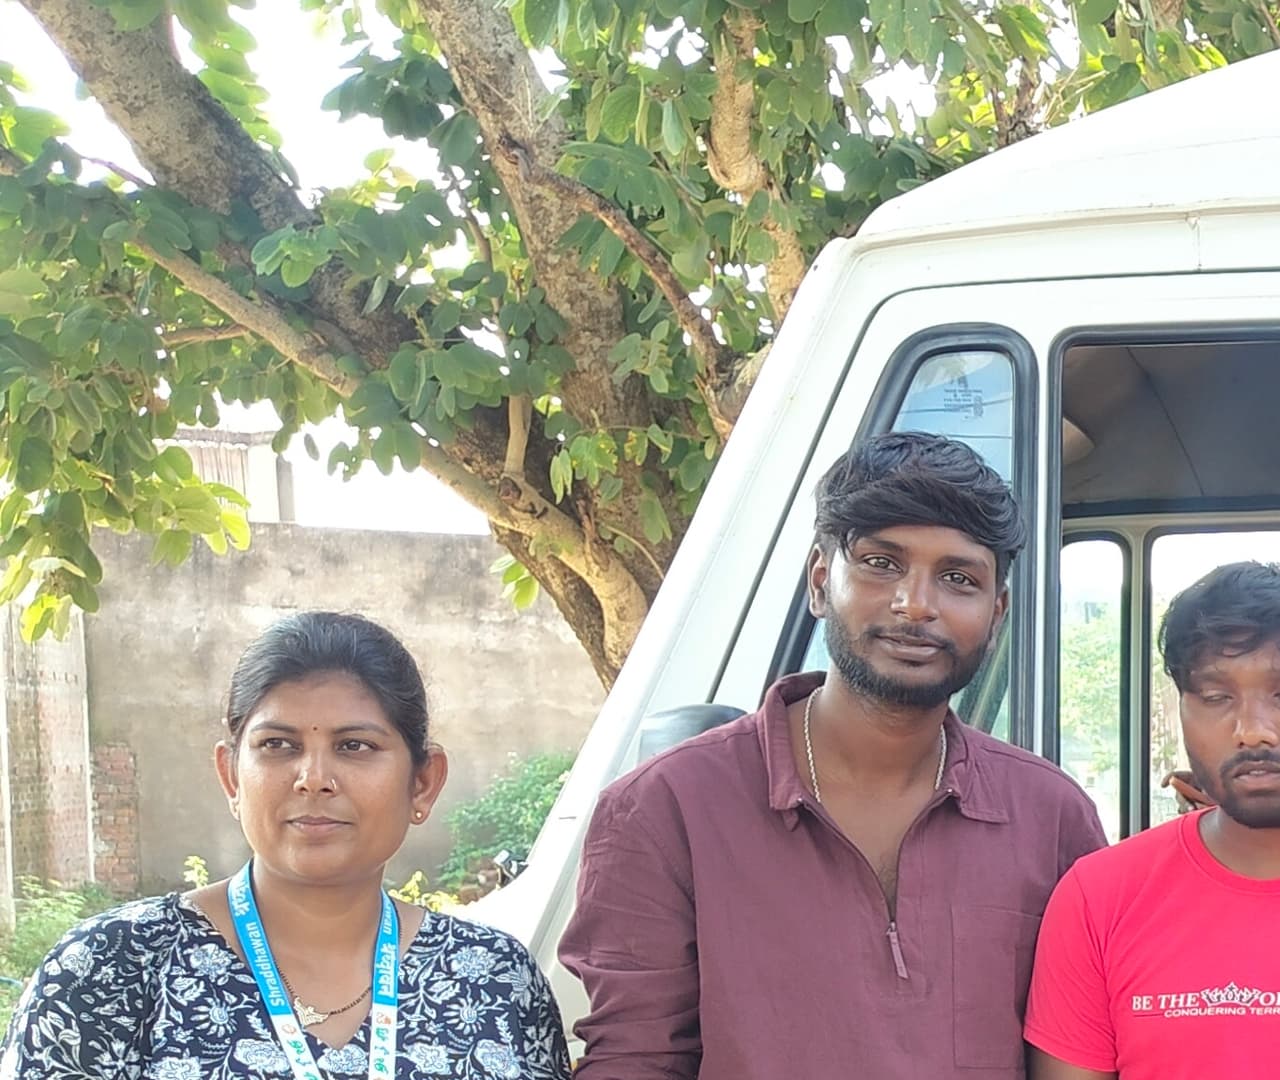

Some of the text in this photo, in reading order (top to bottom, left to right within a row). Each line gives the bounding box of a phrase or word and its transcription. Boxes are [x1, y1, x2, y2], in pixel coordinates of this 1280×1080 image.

[245, 920, 286, 1008] Shraddhawan
[1132, 994, 1153, 1011] BE
[1157, 992, 1201, 1009] THE
[1164, 1006, 1247, 1019] CONQUERING
